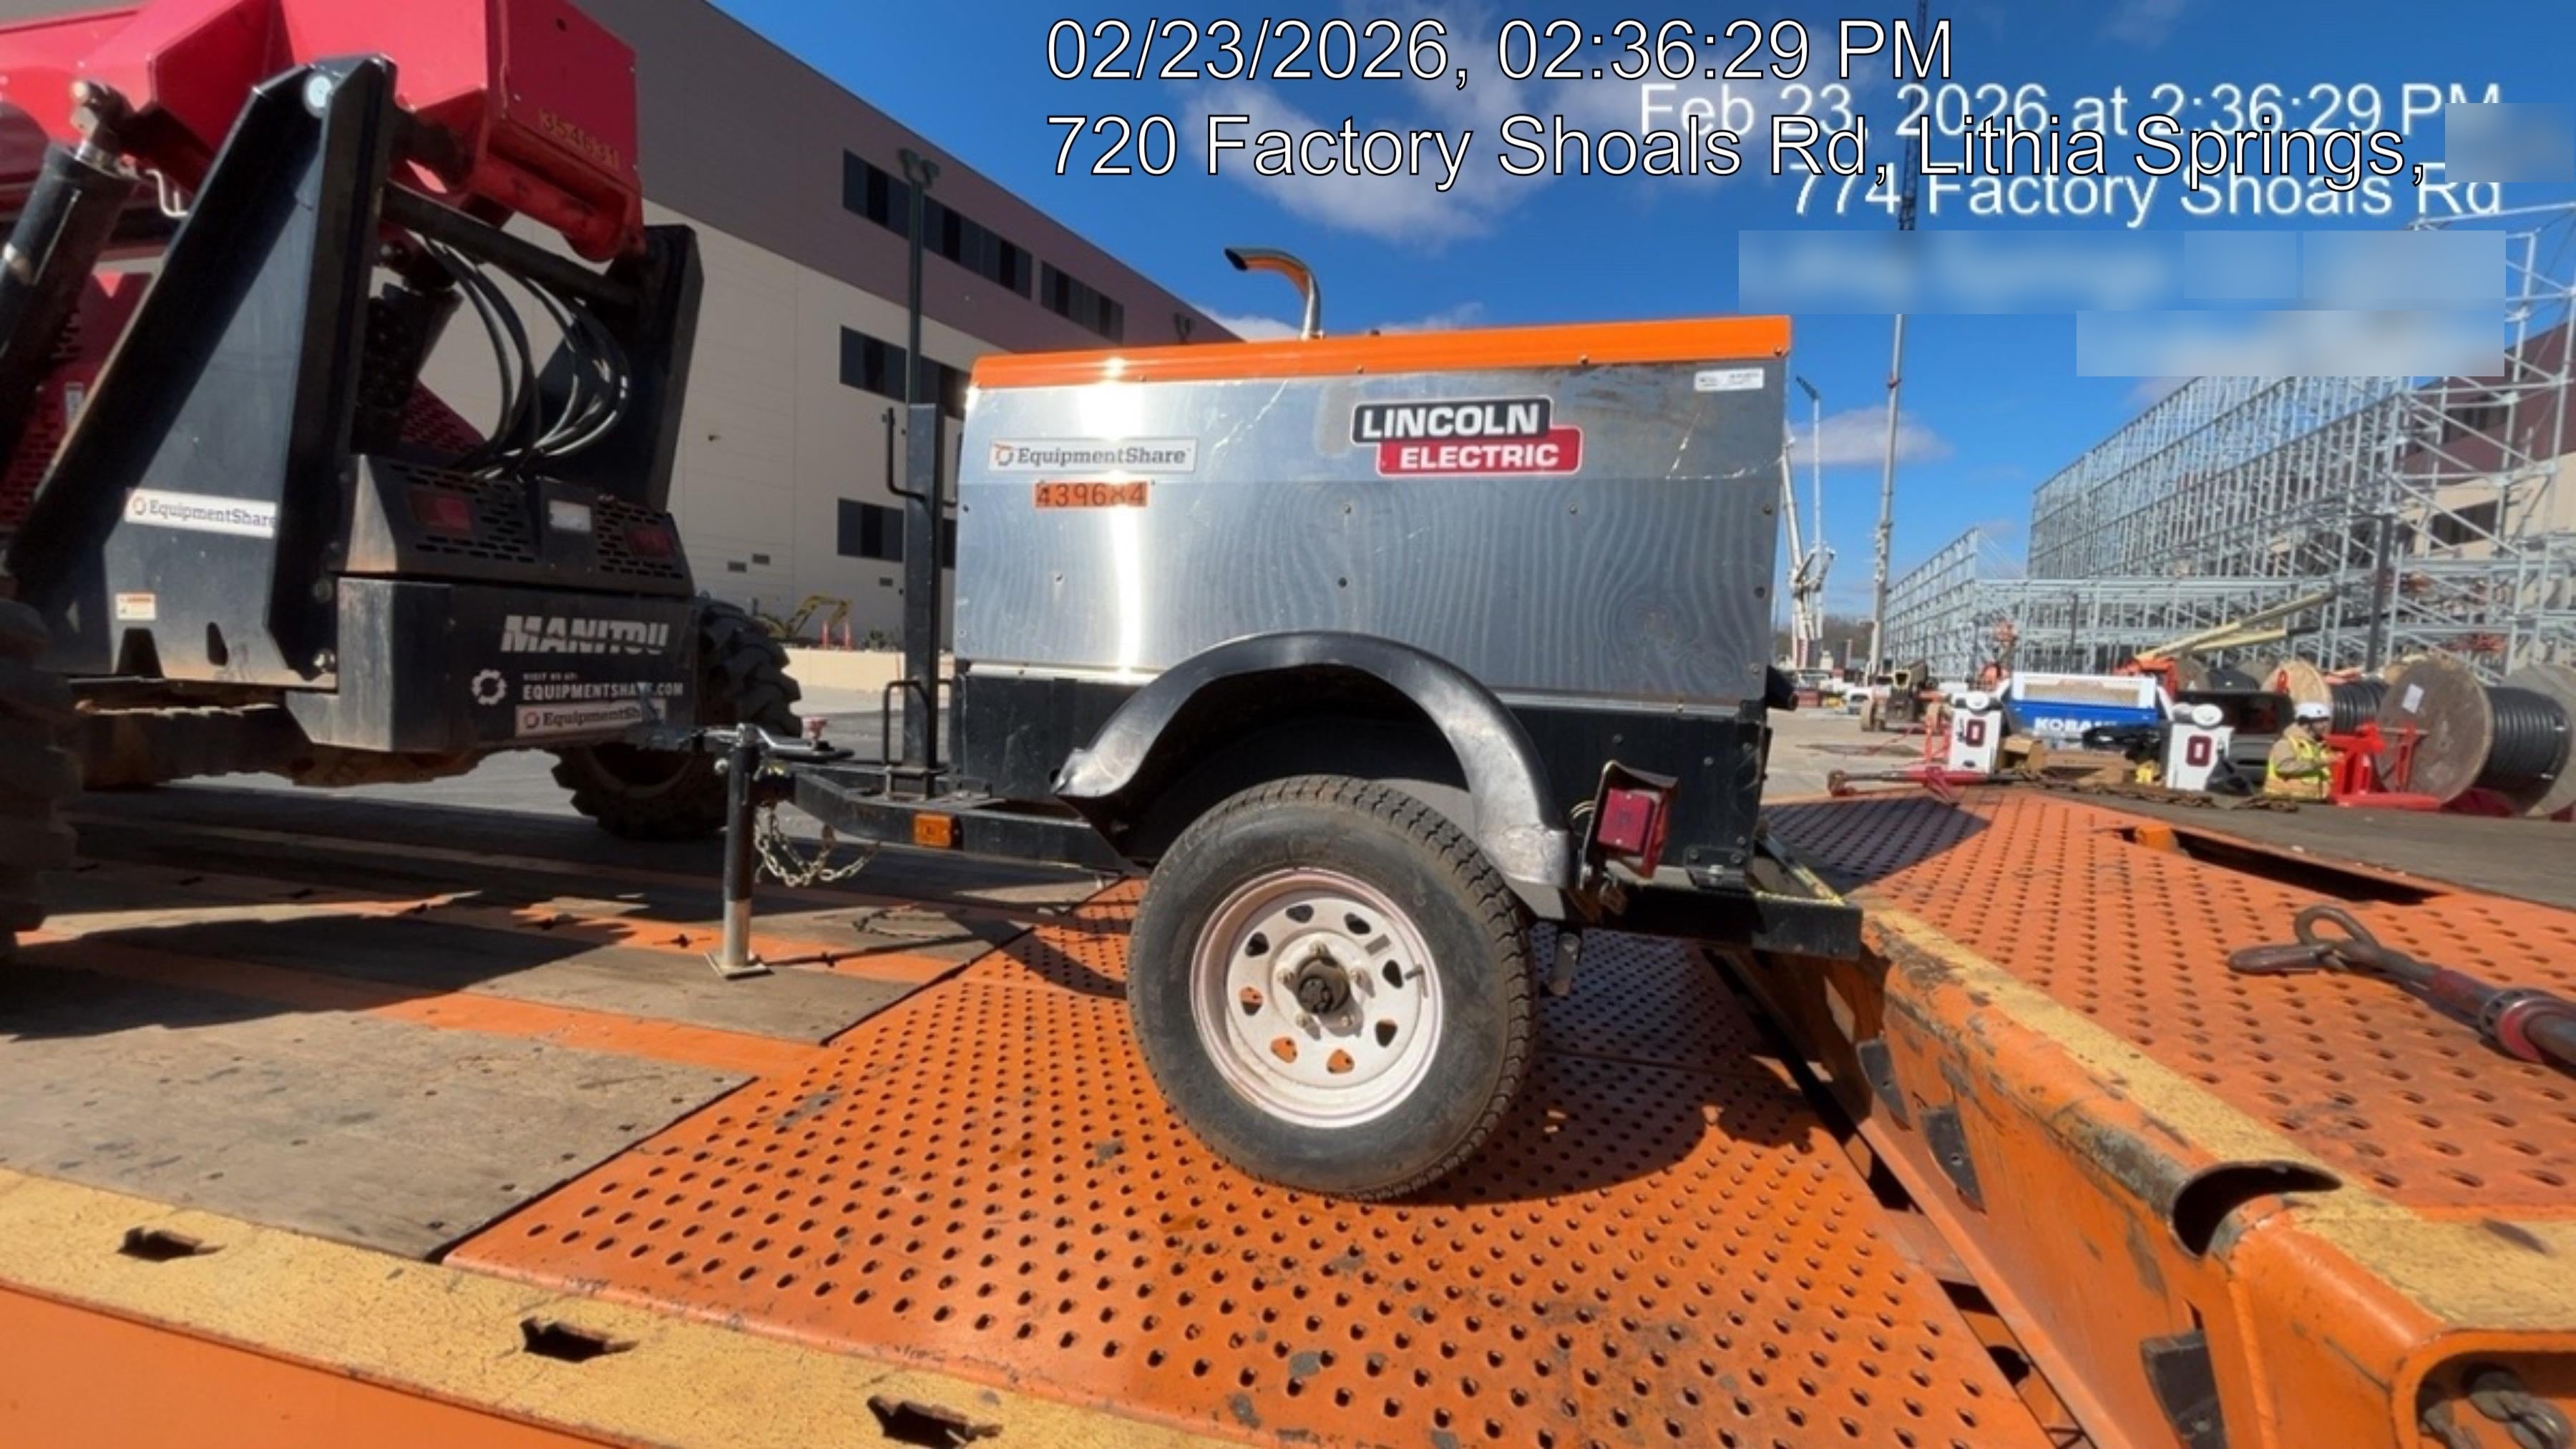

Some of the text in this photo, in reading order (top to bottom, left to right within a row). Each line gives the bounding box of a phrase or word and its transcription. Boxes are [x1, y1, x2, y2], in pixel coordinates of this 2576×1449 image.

[1362, 403, 1539, 439] LINCOLN
[1017, 447, 1186, 467] EquipmentShare
[1400, 443, 1559, 469] ELECTRIC
[501, 615, 669, 655] MANITOU
